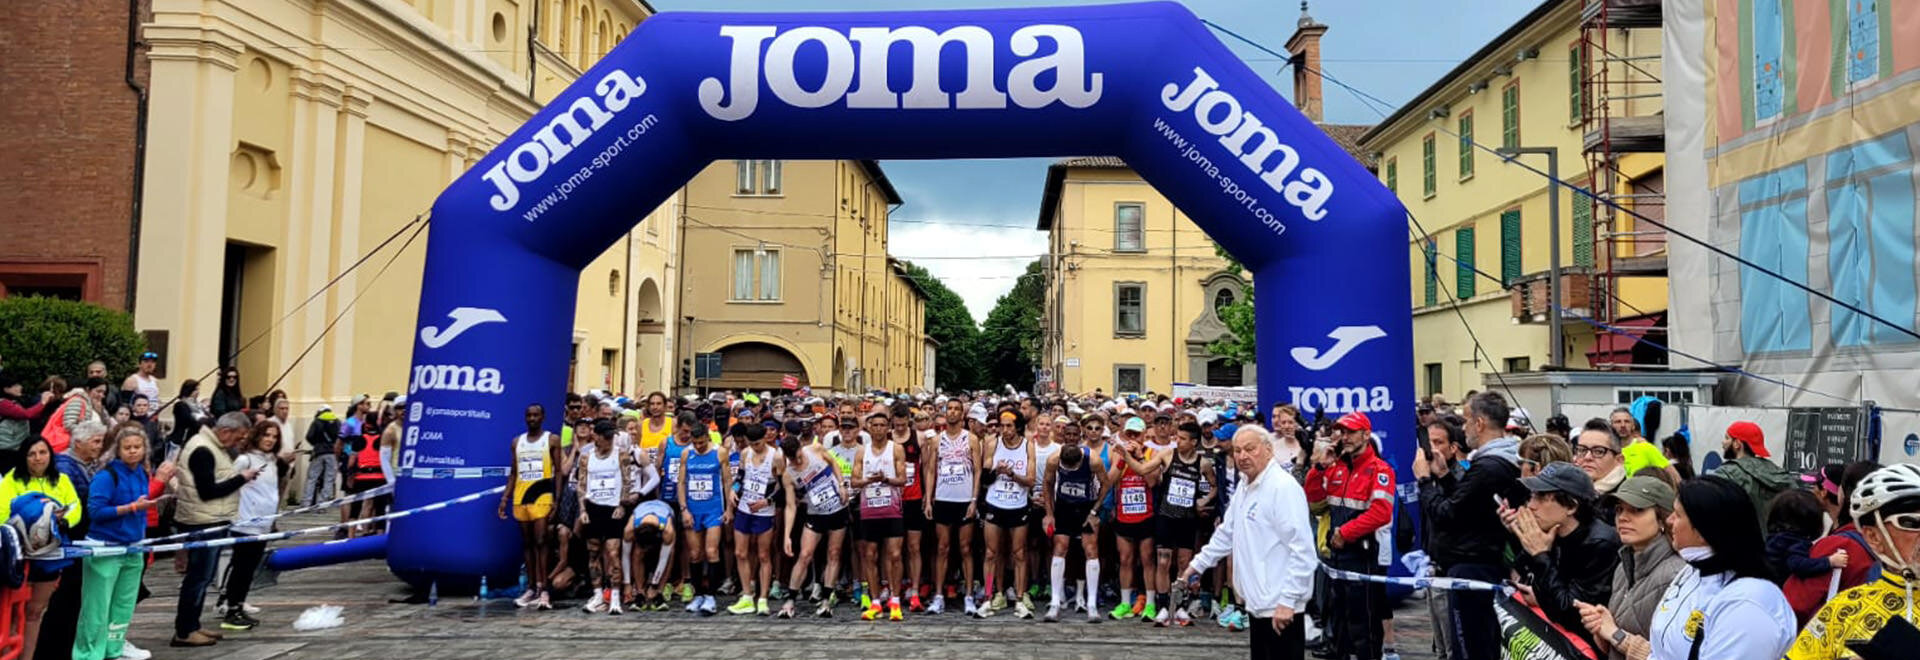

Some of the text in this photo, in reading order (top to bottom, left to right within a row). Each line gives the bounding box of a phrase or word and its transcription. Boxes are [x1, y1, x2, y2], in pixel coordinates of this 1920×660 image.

[523, 113, 659, 222] www.joma-sport.com
[1153, 117, 1286, 235] www.joma-sport.com
[695, 481, 706, 491] 15
[750, 482, 760, 492] 10
